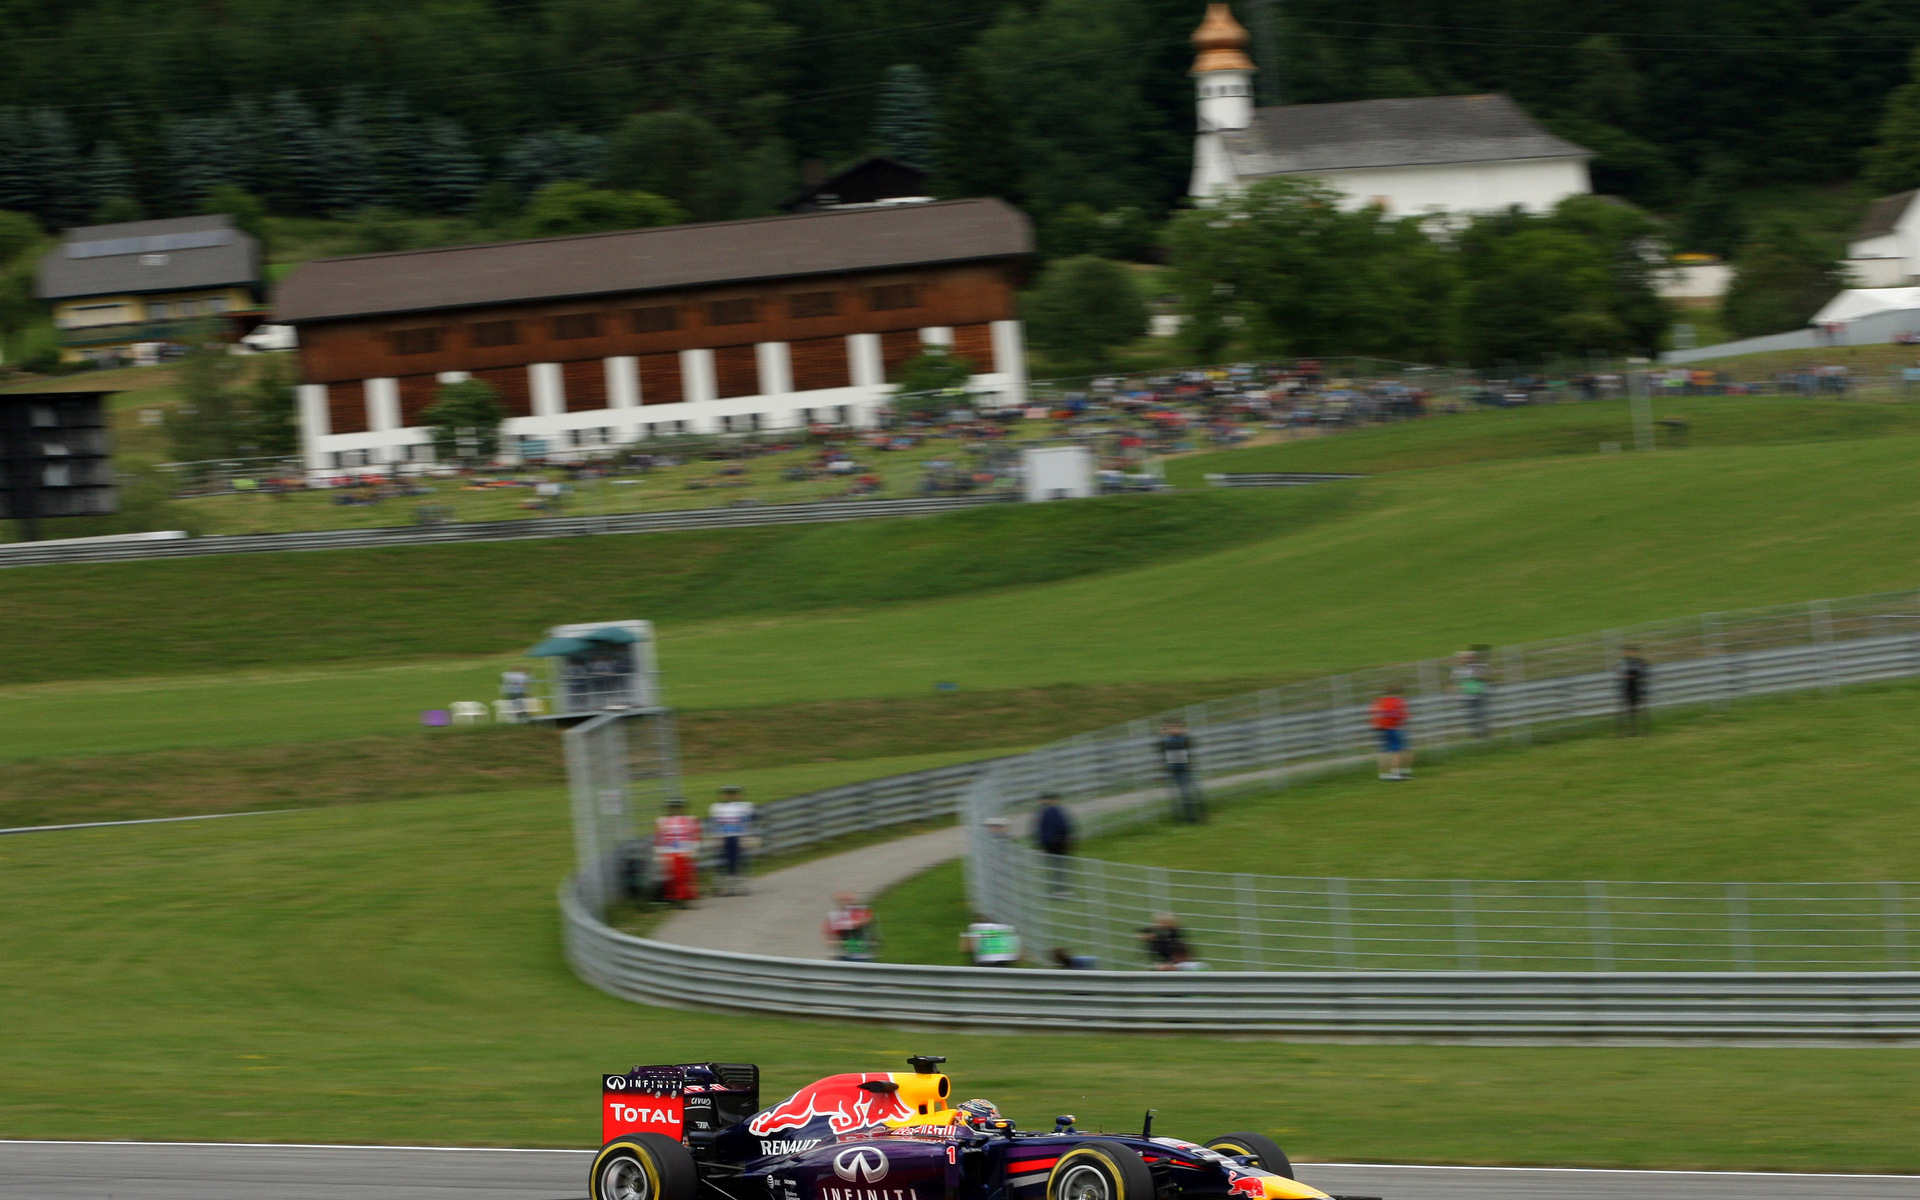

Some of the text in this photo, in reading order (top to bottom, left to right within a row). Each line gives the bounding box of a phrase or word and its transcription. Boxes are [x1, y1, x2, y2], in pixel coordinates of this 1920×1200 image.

[629, 1079, 682, 1089] INFINITI
[609, 1103, 681, 1124] TOTAL
[759, 1139, 822, 1156] RENAULT
[946, 1145, 956, 1164] 1
[822, 1187, 918, 1200] INFINITI
